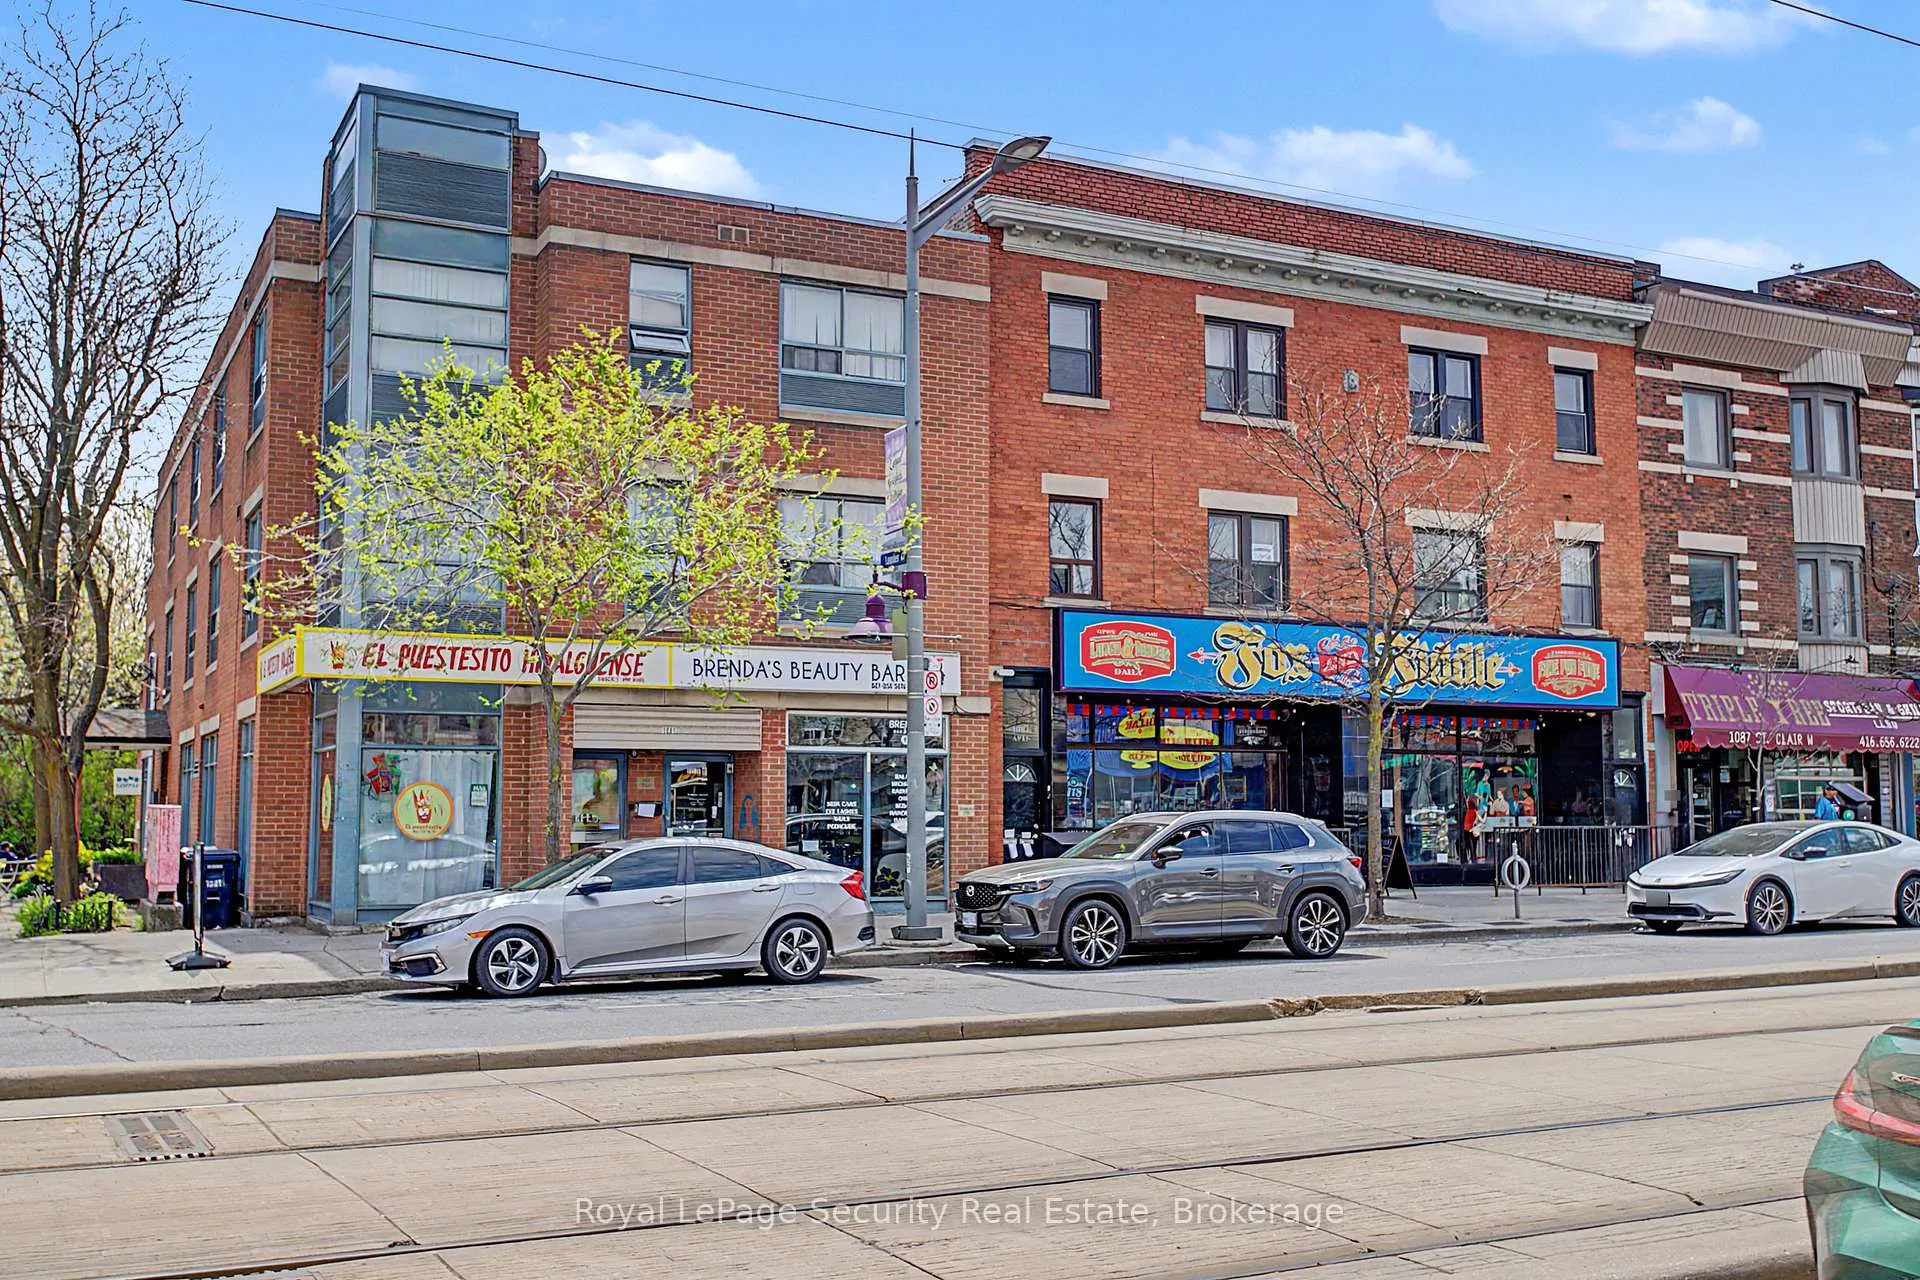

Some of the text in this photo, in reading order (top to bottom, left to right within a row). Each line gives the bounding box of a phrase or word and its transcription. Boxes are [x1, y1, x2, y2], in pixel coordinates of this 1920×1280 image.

[362, 642, 388, 668] EL
[398, 644, 511, 672] PUESTESITO
[693, 658, 906, 682] BRENDA'S BEAUTY BAR
[1114, 668, 1143, 676] DAILY
[1681, 691, 1762, 723] TRIPLE
[1729, 731, 1750, 744] 1087
[1775, 733, 1803, 746] CLAIR
[1807, 734, 1814, 746] W
